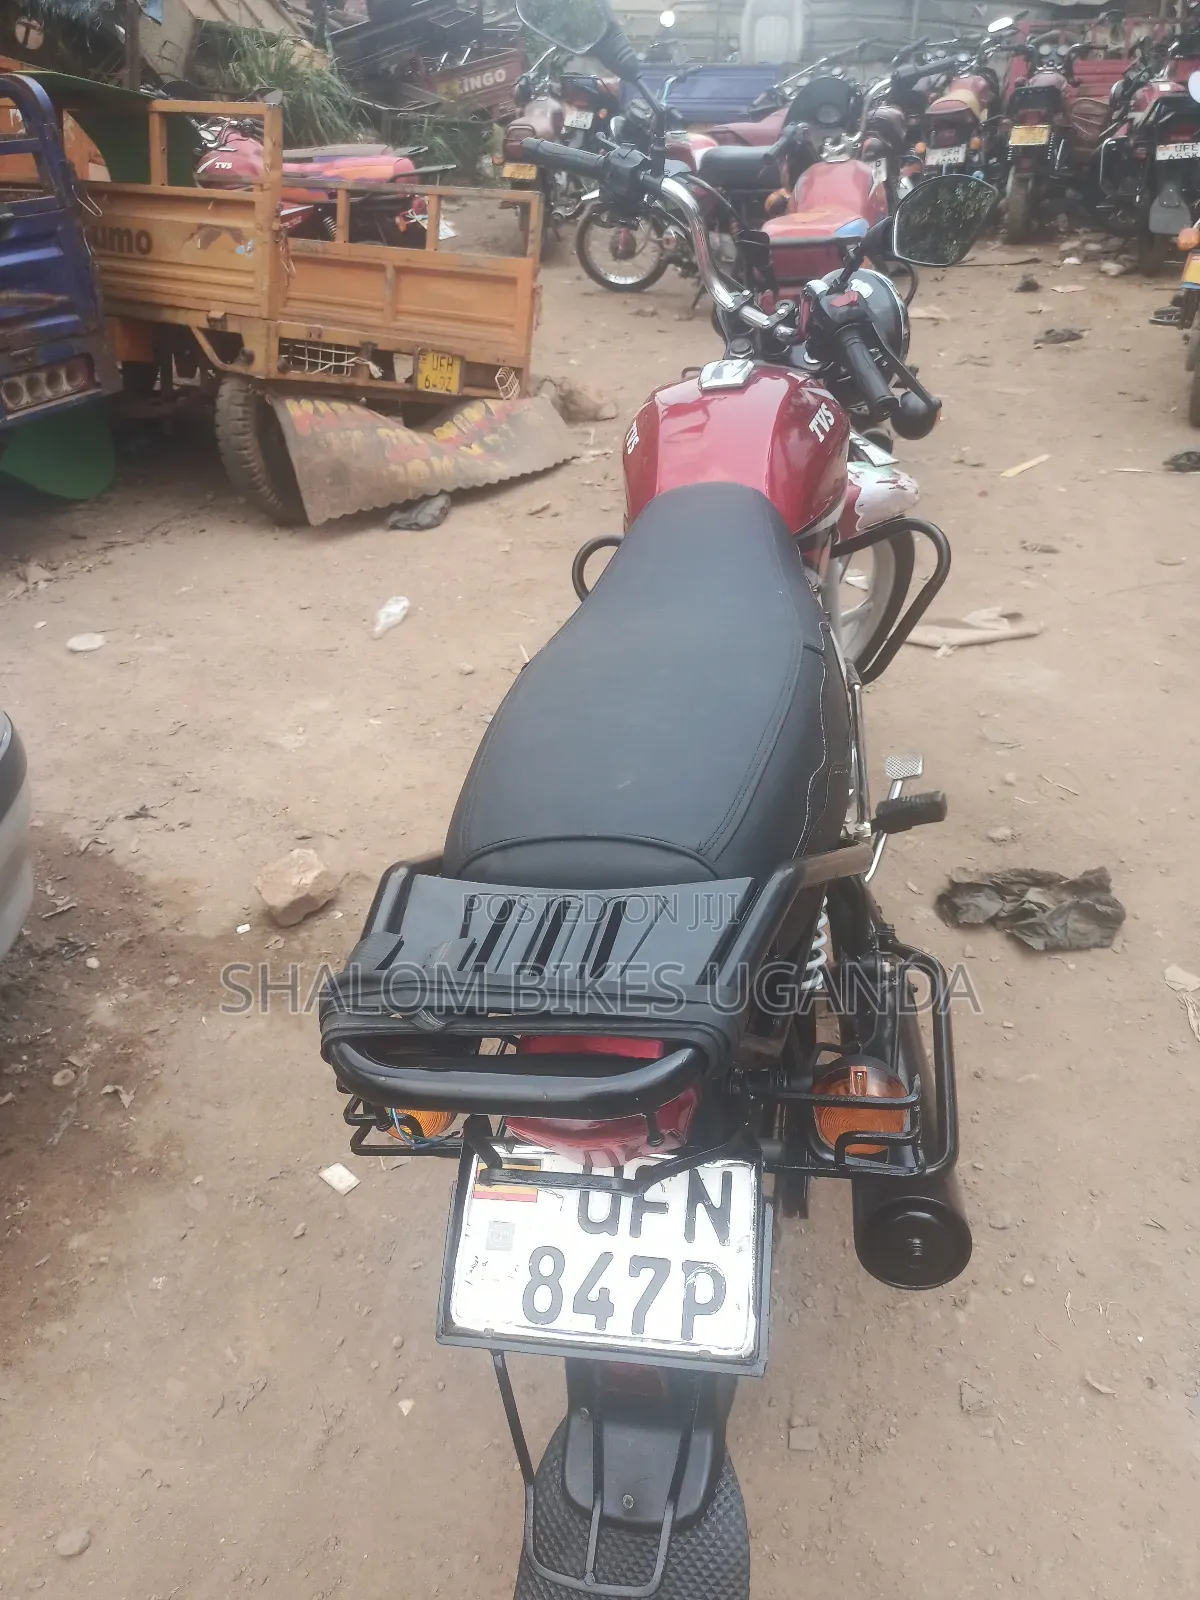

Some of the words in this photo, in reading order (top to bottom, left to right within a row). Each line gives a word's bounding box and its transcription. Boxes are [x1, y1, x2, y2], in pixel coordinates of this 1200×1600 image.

[214, 161, 233, 169] TVS
[808, 401, 836, 444] TVS
[521, 1245, 727, 1341] 847P
